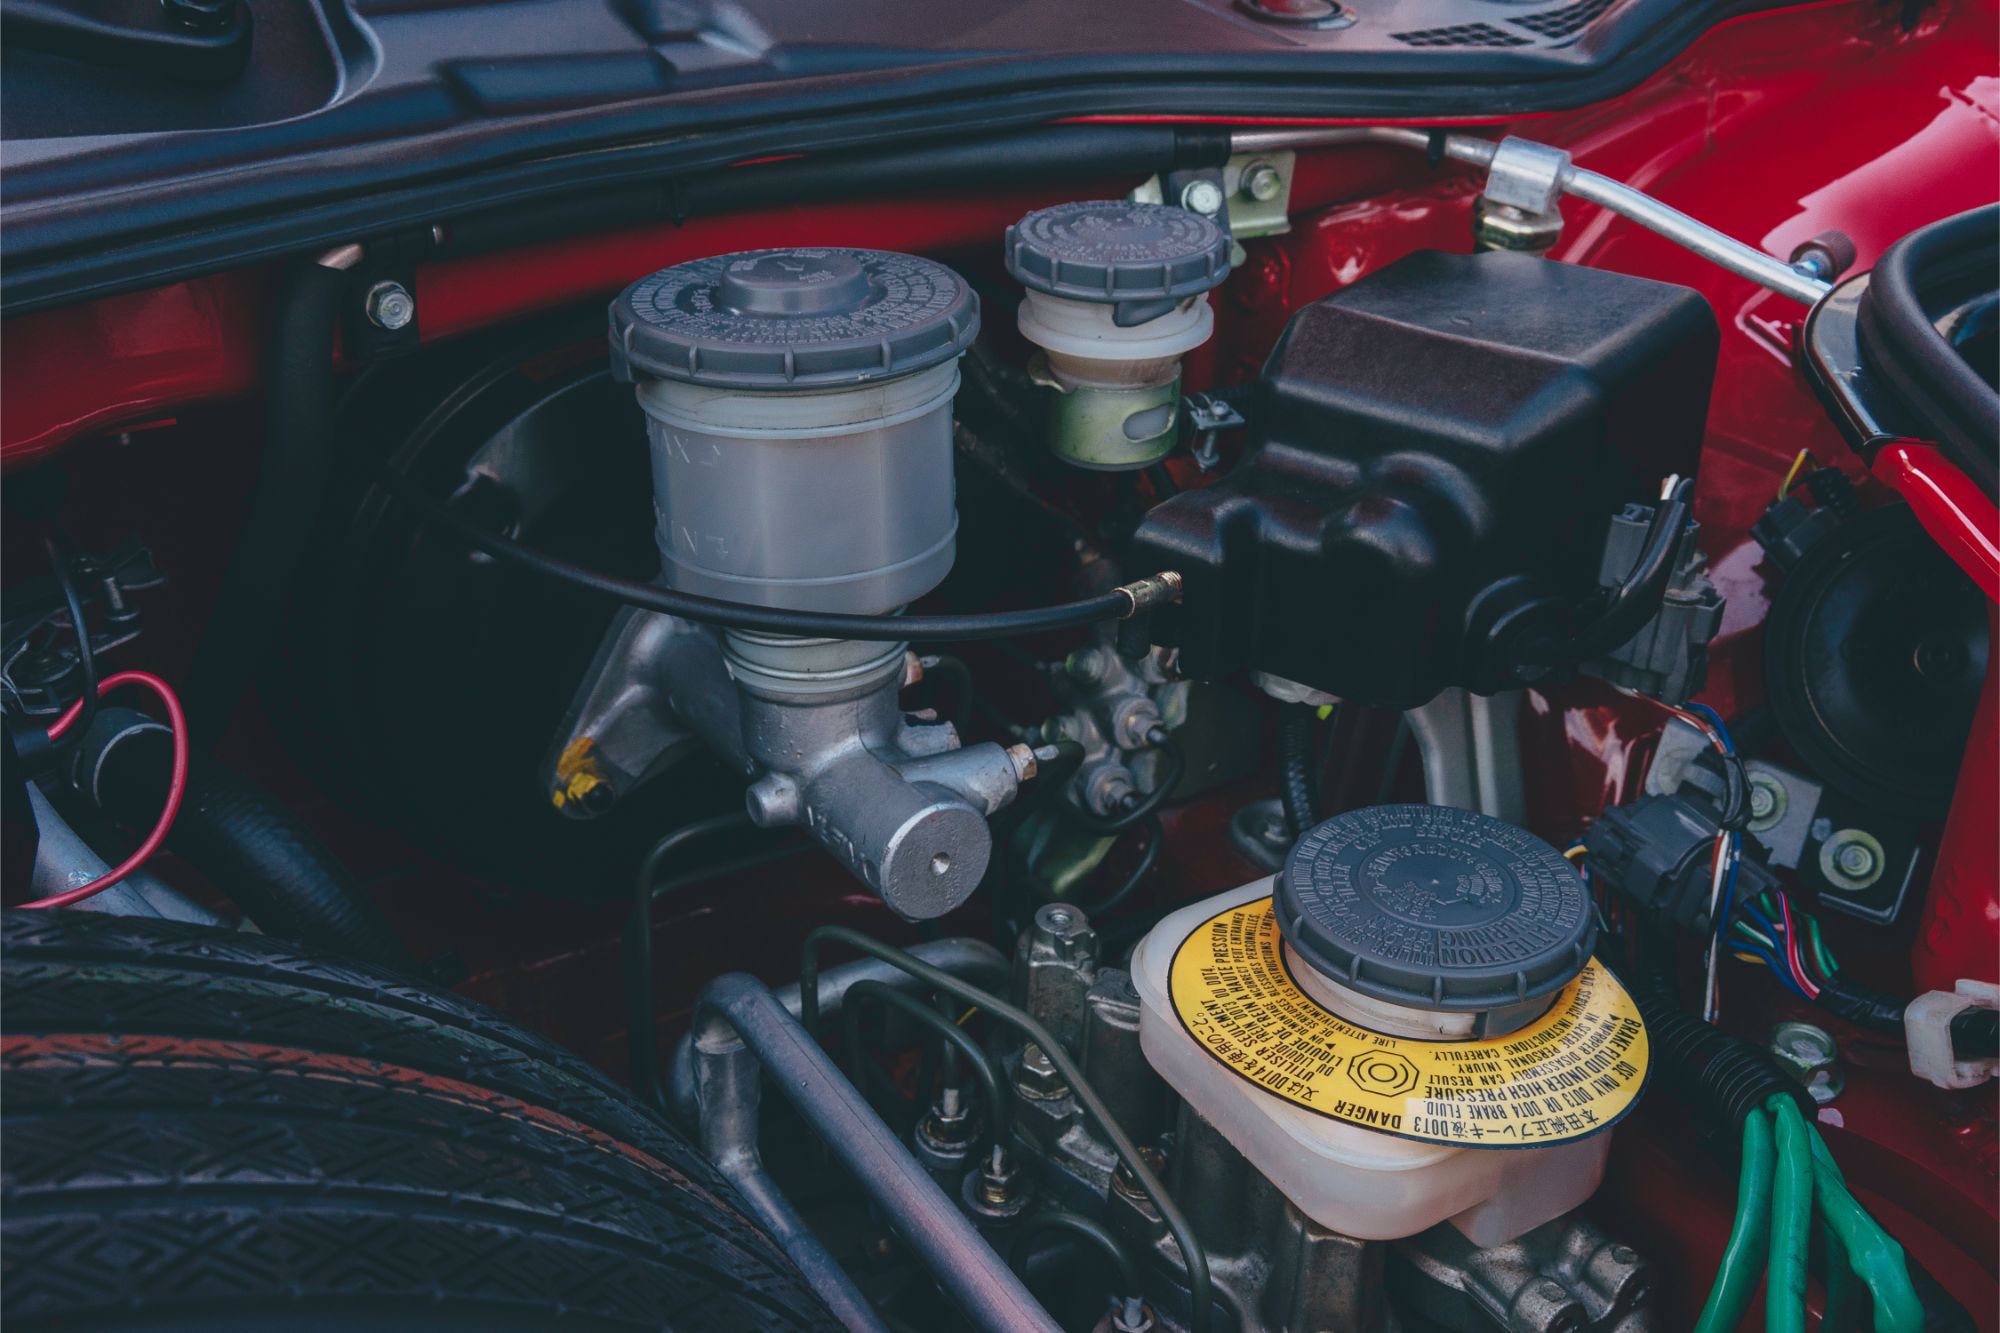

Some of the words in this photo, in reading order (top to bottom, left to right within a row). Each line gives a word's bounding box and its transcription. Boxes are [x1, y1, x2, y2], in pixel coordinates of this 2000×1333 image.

[1461, 811, 1479, 826] LE
[1440, 911, 1533, 946] WARNING
[1210, 922, 1230, 964] PRESSION
[1441, 925, 1560, 965] ATTENTION
[1230, 947, 1244, 963] PEUT
[1259, 941, 1286, 986] INSTRUCTIONS
[1216, 966, 1244, 993] HAUTE
[1235, 966, 1266, 1001] INCORRECT
[1249, 962, 1279, 997] BLESSURES
[1210, 988, 1229, 999] OU
[1281, 987, 1299, 1001] LES
[1564, 988, 1591, 1020] SERVICE
[1221, 1001, 1247, 1021] DOT3
[1241, 1001, 1276, 1028] FREIN
[1261, 1001, 1308, 1036] DEMONTAGE
[1274, 998, 1318, 1029] SERIEUSES
[1294, 1000, 1367, 1041] ATTENTIVEMENT
[1582, 1012, 1599, 1024] IN
[1199, 999, 1257, 1048] SEULEMENT
[1240, 1021, 1273, 1043] FREIN
[1271, 1026, 1292, 1040] DE
[1318, 1027, 1333, 1038] DE
[1608, 1017, 1641, 1052] BRAKE
[1307, 1034, 1324, 1045] UN
[1371, 1037, 1395, 1048] LIRE
[1502, 1017, 1572, 1056] INSTRUCTIONS
[1556, 1023, 1591, 1049] SEVERE
[1269, 1041, 1314, 1068] LIQUIDE
[1288, 1037, 1343, 1067] LIQUIDE
[1427, 1048, 1499, 1061] CAREFULLY.
[1502, 1044, 1560, 1069] PERSONAL
[1583, 1046, 1620, 1074] FLUID
[1254, 1047, 1314, 1082] UTILISER
[1314, 1063, 1334, 1077] DU
[1451, 1061, 1501, 1074] INJURY.
[1509, 1051, 1580, 1083] DISASSEMBLY
[1611, 1060, 1638, 1080] USE
[1427, 1074, 1473, 1087] RESULT
[1478, 1073, 1504, 1086] CAN
[1541, 1065, 1591, 1092] UNDER
[1589, 1074, 1619, 1097] ONLY
[1423, 1085, 1506, 1103] PRESSURE
[1506, 1081, 1545, 1100] HIGH
[1560, 1087, 1593, 1108] DOT3
[1333, 1100, 1401, 1130] DANGER
[1422, 1100, 1460, 1119] FLUID.
[1465, 1104, 1506, 1120] BRAKE
[1509, 1100, 1542, 1119] DOT4
[1541, 1096, 1562, 1113] OR
